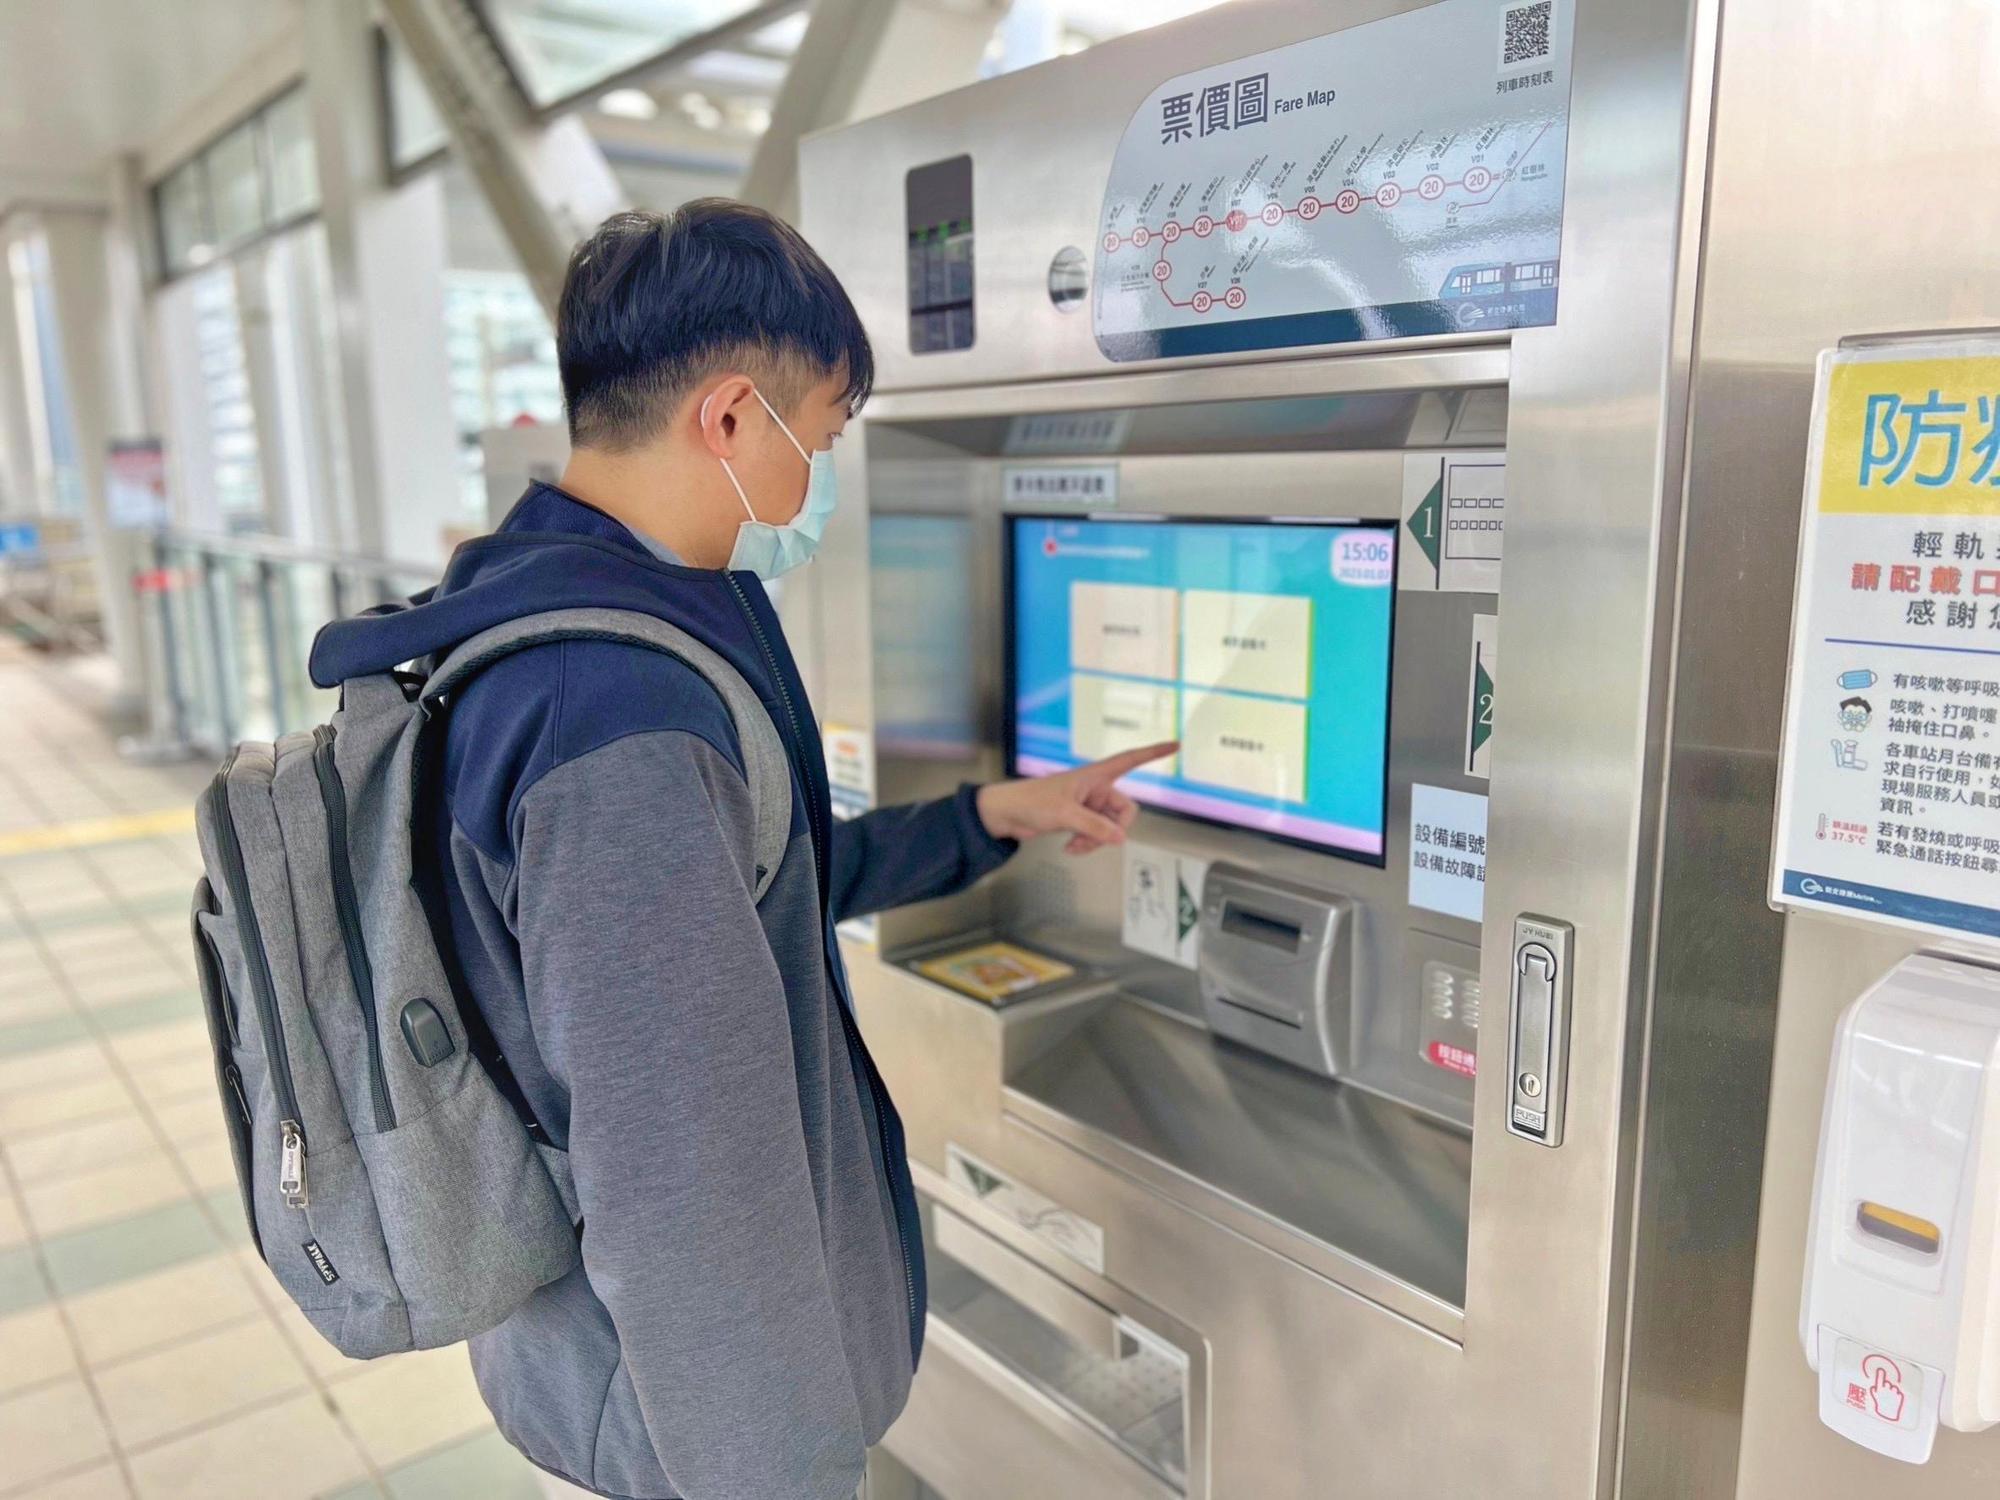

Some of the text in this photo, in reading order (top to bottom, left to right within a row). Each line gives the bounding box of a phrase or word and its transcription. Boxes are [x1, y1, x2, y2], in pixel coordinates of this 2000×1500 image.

[1496, 71, 1552, 94] 列車時刻表
[1161, 73, 1269, 145] 票價圖
[1274, 90, 1336, 114] Fare Map
[1424, 181, 1439, 194] 20
[1469, 173, 1484, 187] 20
[1341, 196, 1354, 208] 20
[1381, 189, 1395, 201] 20
[1266, 209, 1278, 220] 20
[1303, 203, 1315, 214] 20
[1166, 226, 1177, 236] 20
[1198, 222, 1209, 232] 20
[1136, 232, 1147, 242] 20
[1157, 266, 1168, 276] 20
[1197, 297, 1208, 307] 20
[1230, 293, 1241, 303] 20
[1424, 506, 1435, 539] 1
[1342, 542, 1389, 562] 15:06
[1912, 530, 2000, 559] 輕軌
[1851, 563, 2000, 597] 請配戴口
[1894, 673, 2000, 697] 有咳嗽等呼吸
[1479, 693, 1494, 725] 2
[1880, 797, 1926, 816] 資訊。
[1414, 822, 1486, 856] 設備編號
[1831, 831, 1866, 846] 37.5°C
[1516, 1108, 1541, 1124] PUSH
[307, 1243, 335, 1283] SPYWALK
